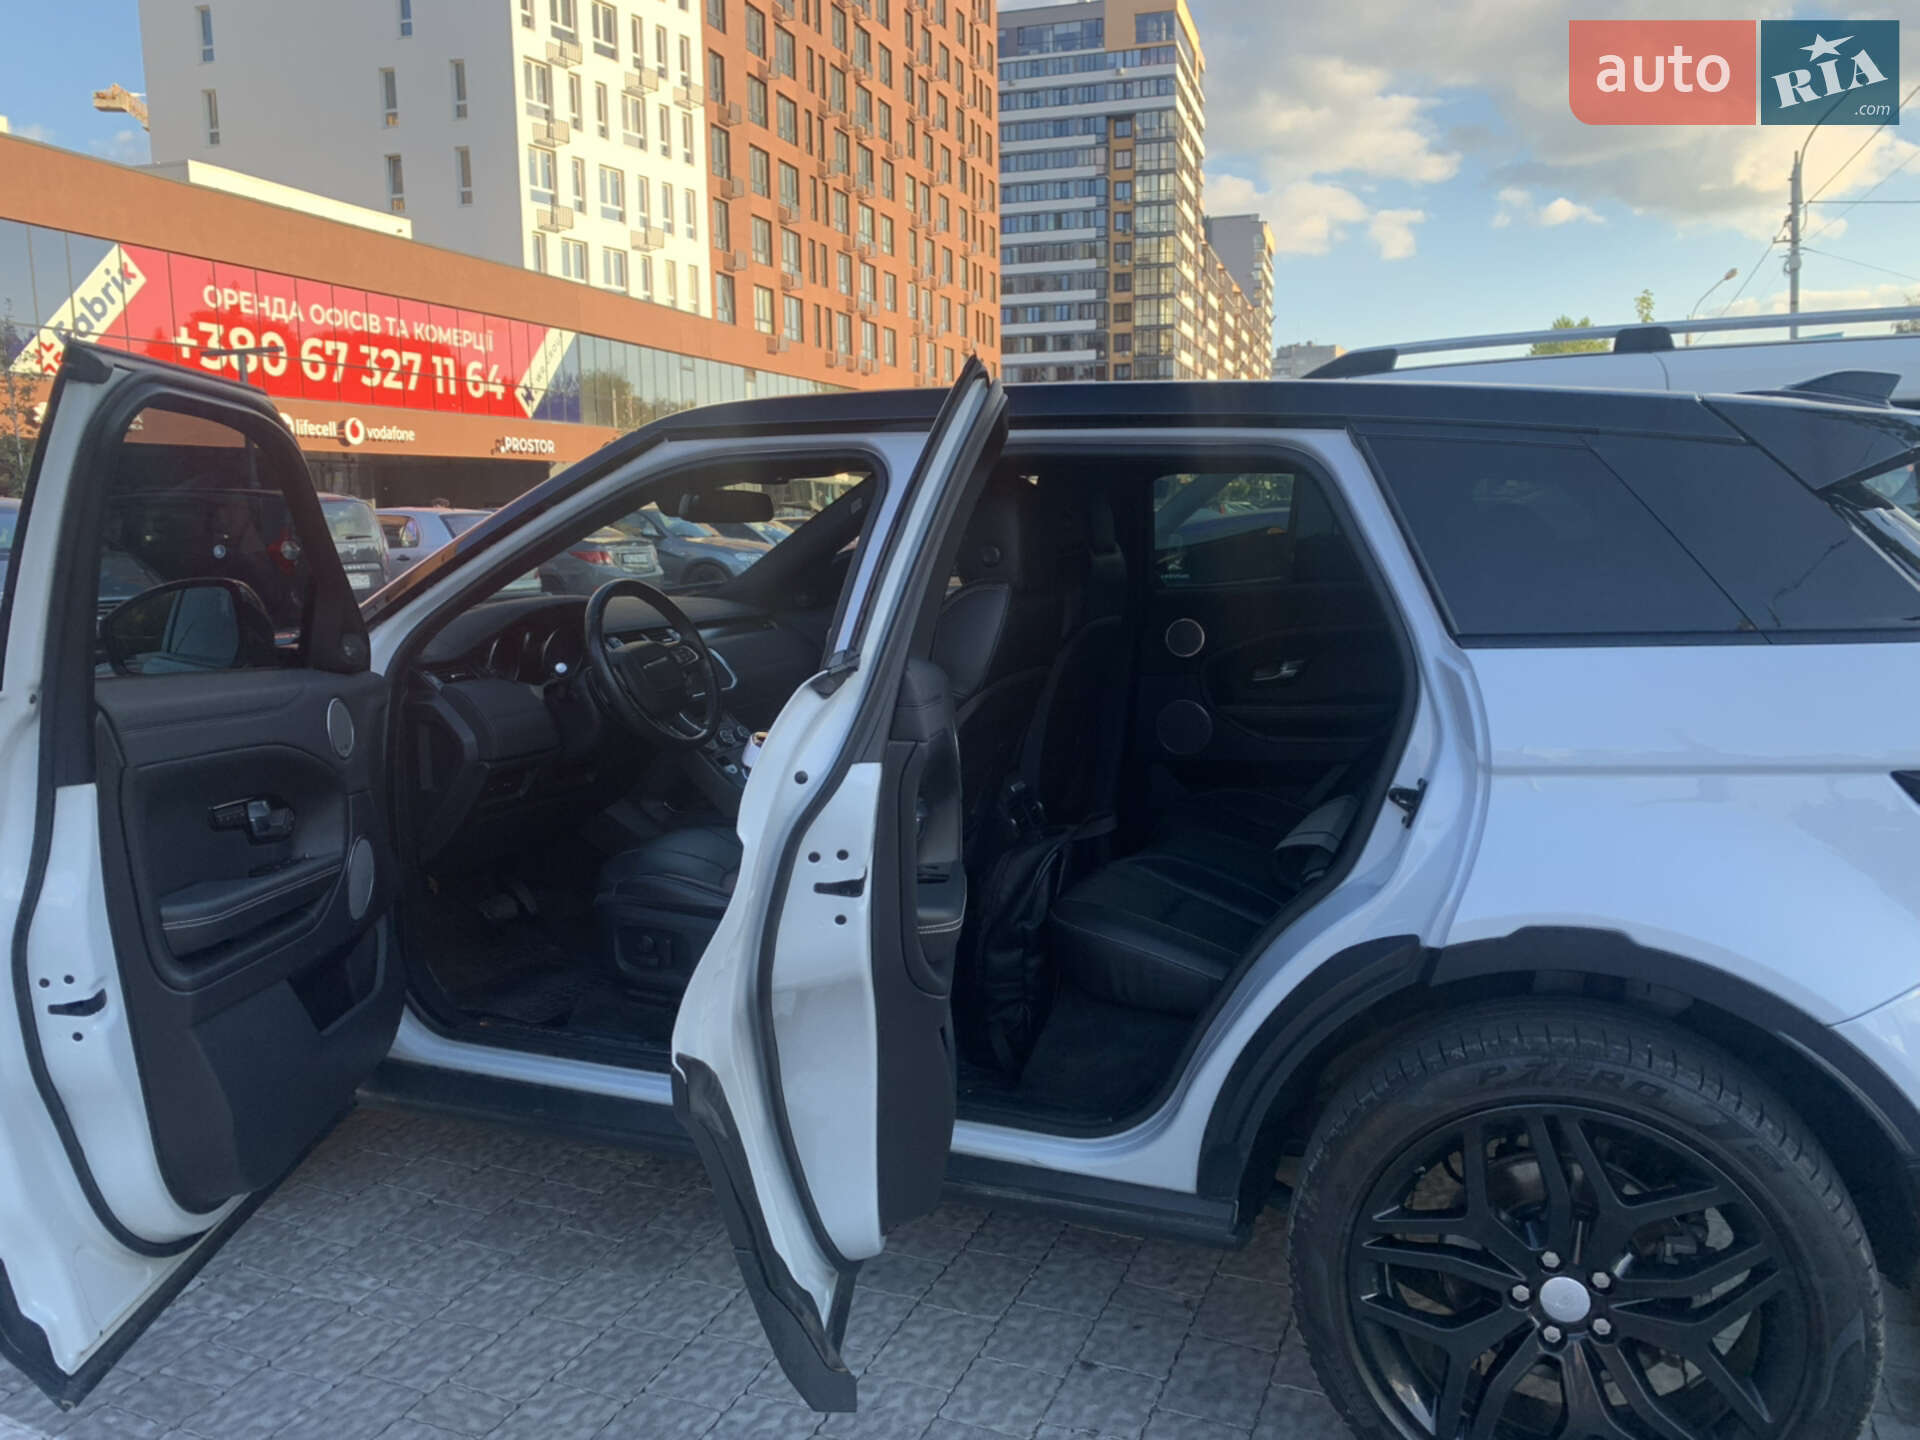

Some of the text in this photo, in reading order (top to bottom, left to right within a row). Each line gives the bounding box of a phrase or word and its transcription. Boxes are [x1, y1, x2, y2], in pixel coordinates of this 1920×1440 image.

[203, 284, 494, 355] ОРЕНДА ОФІСІВ ТА КОМЕРЦІЇ
[172, 321, 505, 400] +380 67 327 11 64
[295, 419, 337, 437] lifecell
[366, 425, 416, 441] vodafone
[504, 436, 555, 454] PROSTOR
